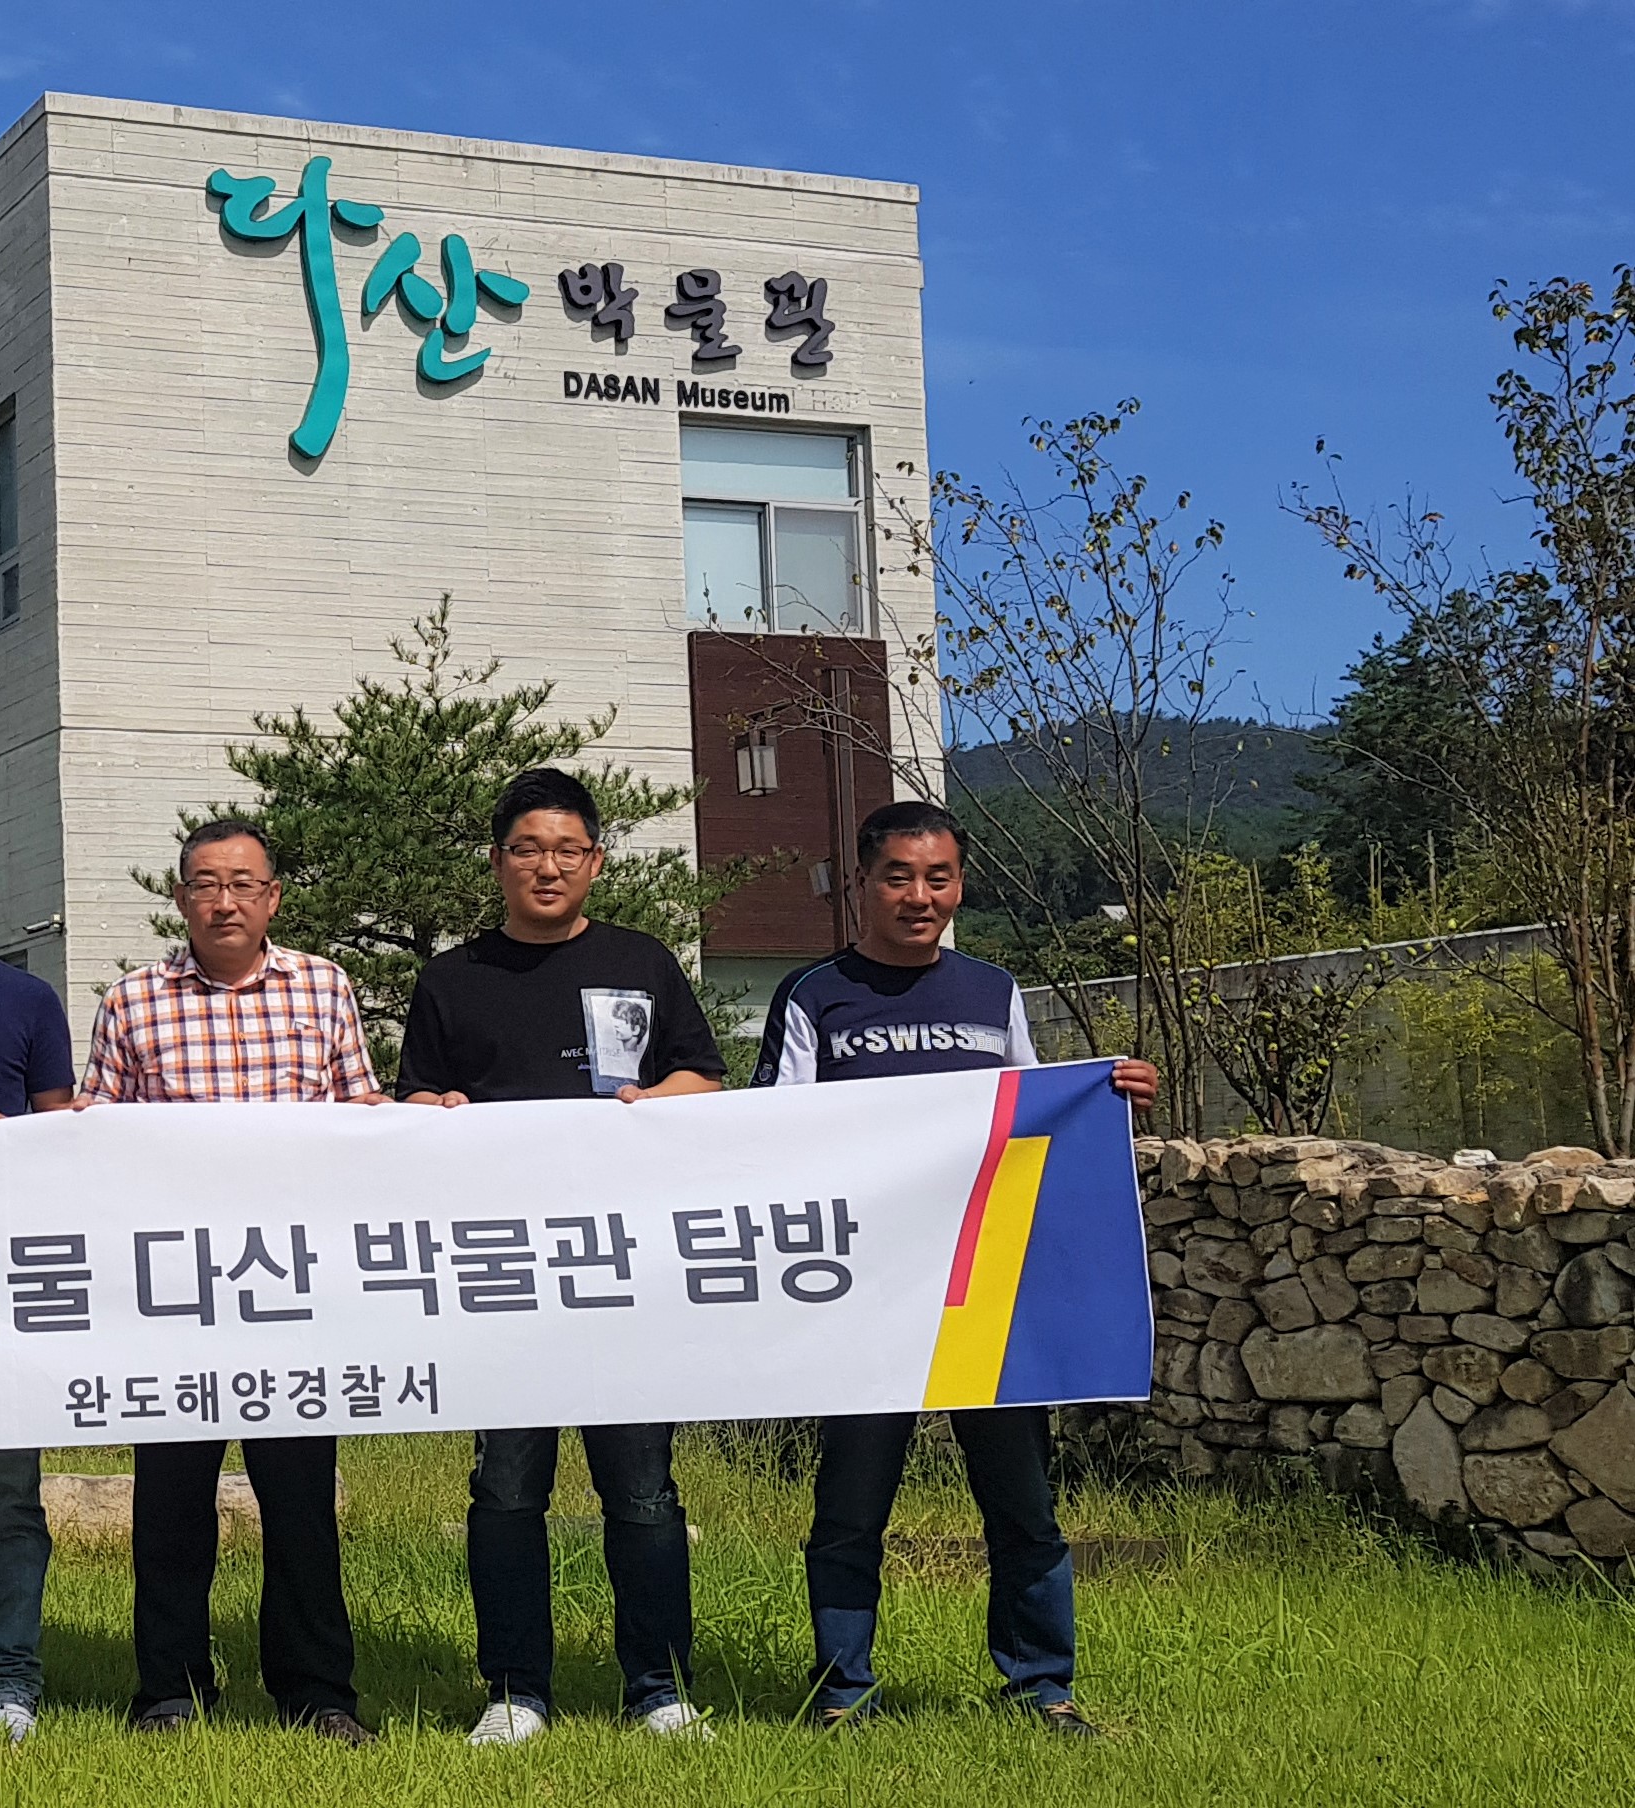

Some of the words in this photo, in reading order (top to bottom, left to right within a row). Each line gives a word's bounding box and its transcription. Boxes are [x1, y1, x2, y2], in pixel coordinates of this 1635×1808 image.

[206, 156, 530, 460] 다산
[558, 262, 836, 367] 박물관
[563, 370, 661, 404] DASAN
[676, 380, 790, 414] Museum
[133, 1224, 318, 1327] 다산
[353, 1212, 638, 1316] 박물관
[671, 1198, 859, 1305] 탐방
[65, 1362, 440, 1428] 완도해양경찰서
